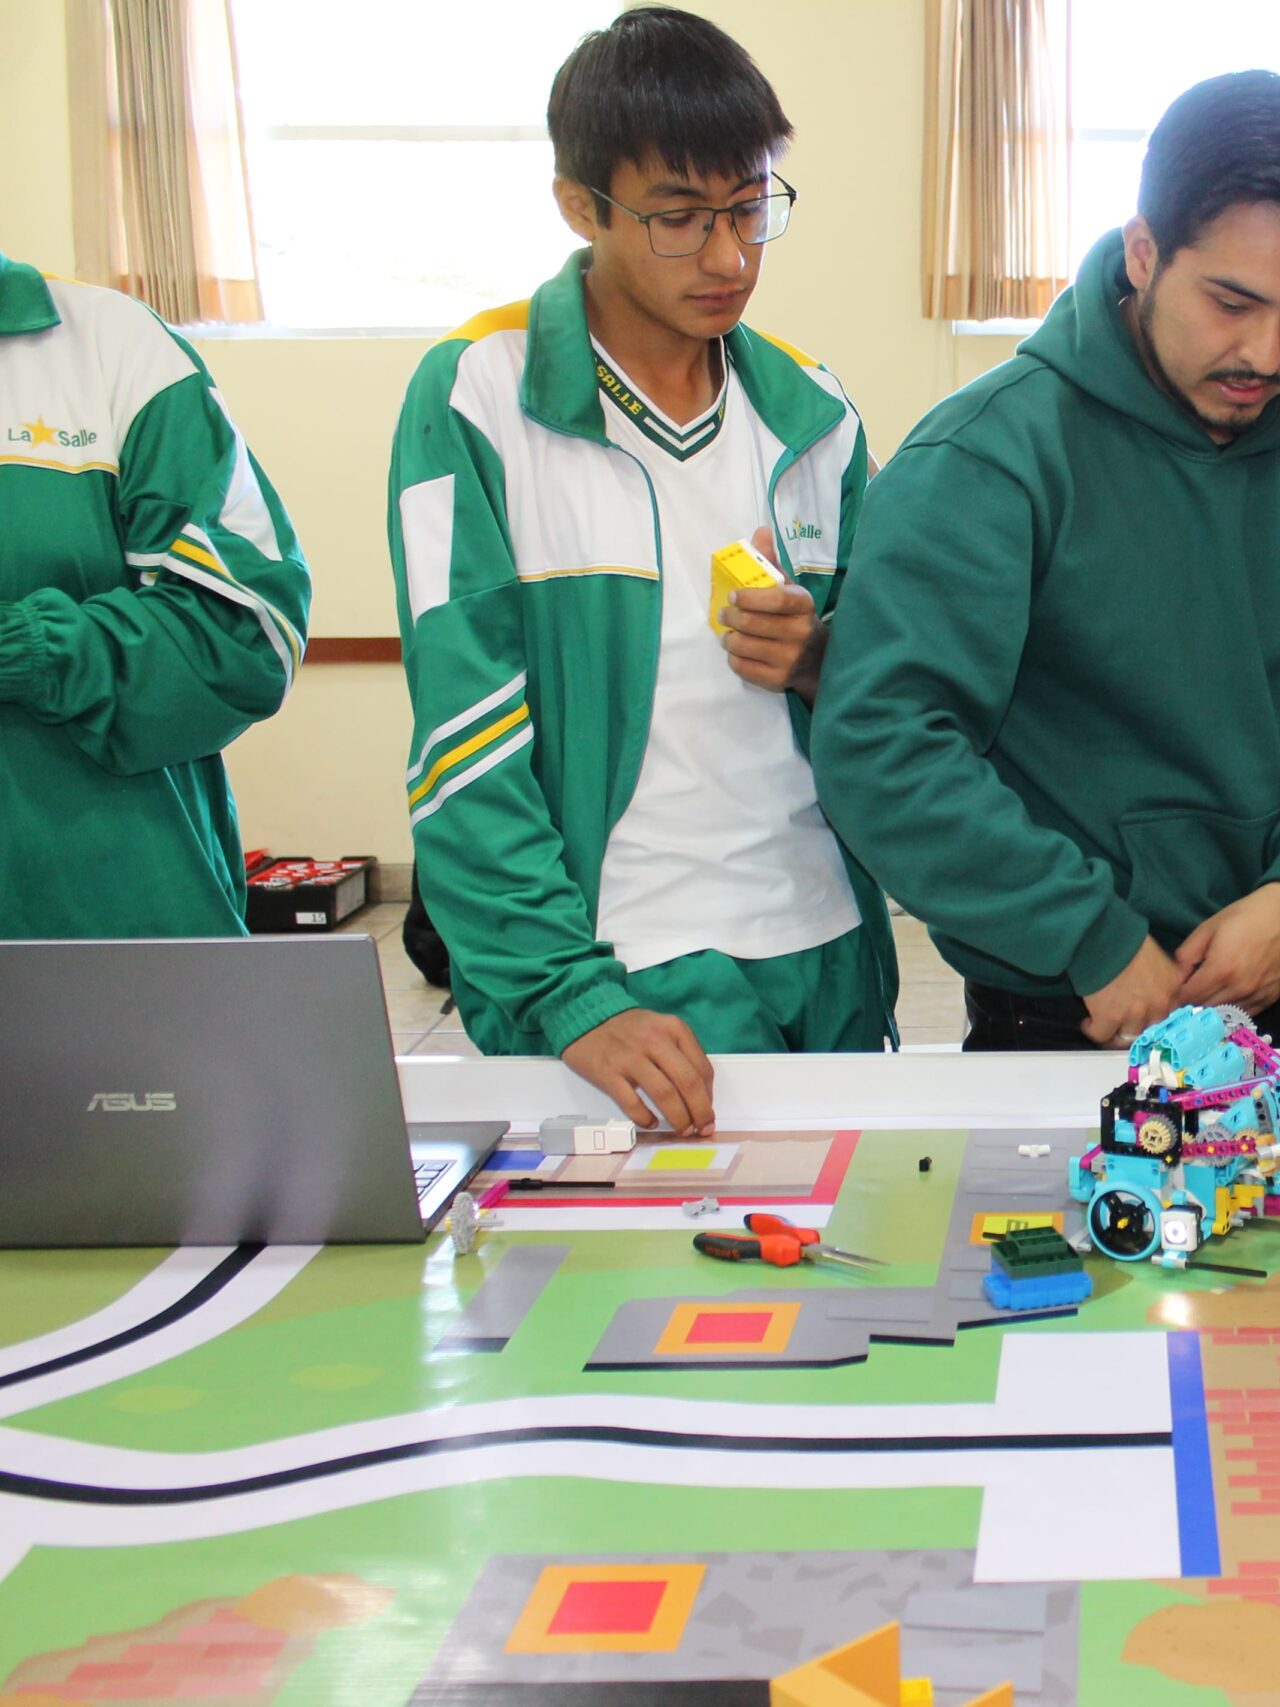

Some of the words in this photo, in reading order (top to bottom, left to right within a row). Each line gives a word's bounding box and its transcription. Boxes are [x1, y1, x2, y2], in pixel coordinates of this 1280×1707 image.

[596, 364, 642, 416] SALLE
[8, 428, 32, 442] La
[57, 428, 98, 447] Salle
[799, 524, 822, 539] alle
[86, 1092, 177, 1112] ASUS
